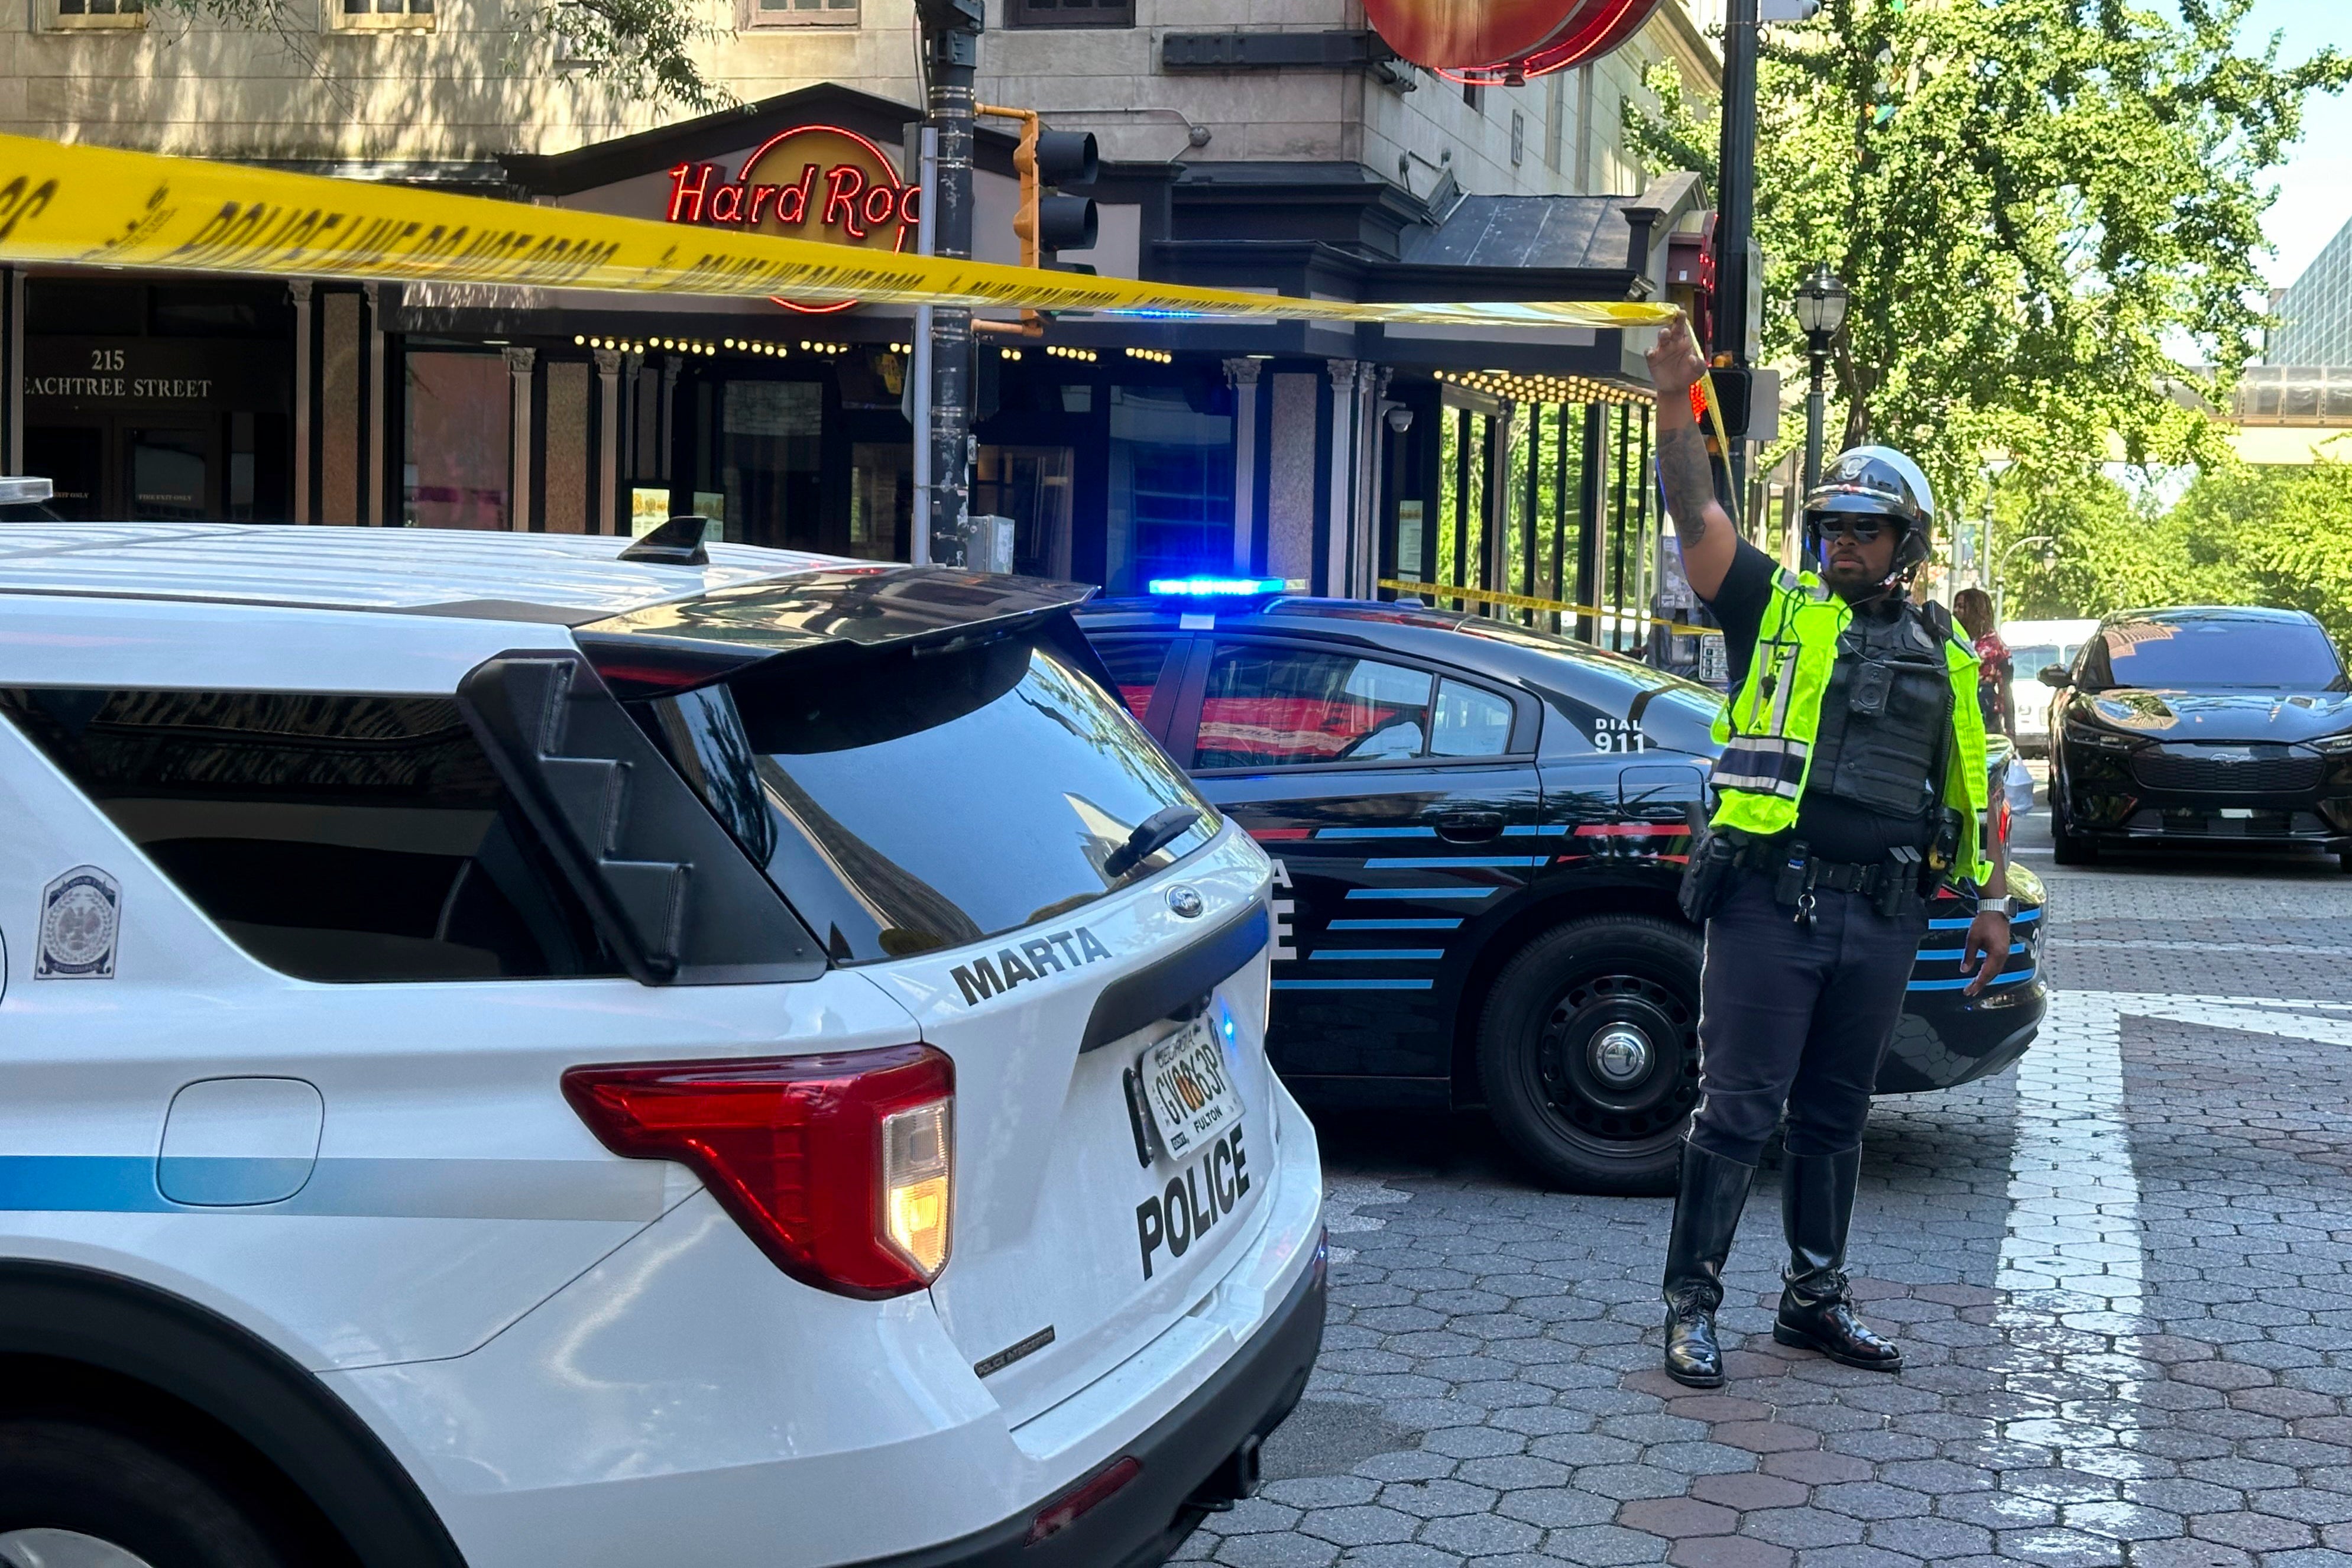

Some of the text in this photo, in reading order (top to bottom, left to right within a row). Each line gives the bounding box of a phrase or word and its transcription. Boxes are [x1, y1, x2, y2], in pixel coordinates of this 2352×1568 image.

[668, 163, 921, 237] Hard Roc
[91, 349, 125, 371] 215
[24, 377, 212, 397] EACHTREE STREET
[1595, 718, 1643, 731] DIAL
[1594, 732, 1644, 754] 911
[950, 926, 1112, 1006] MARTA
[1155, 1043, 1226, 1125] GV0863P
[1193, 1105, 1223, 1133] FULTON
[1136, 1123, 1250, 1281] POLICE
